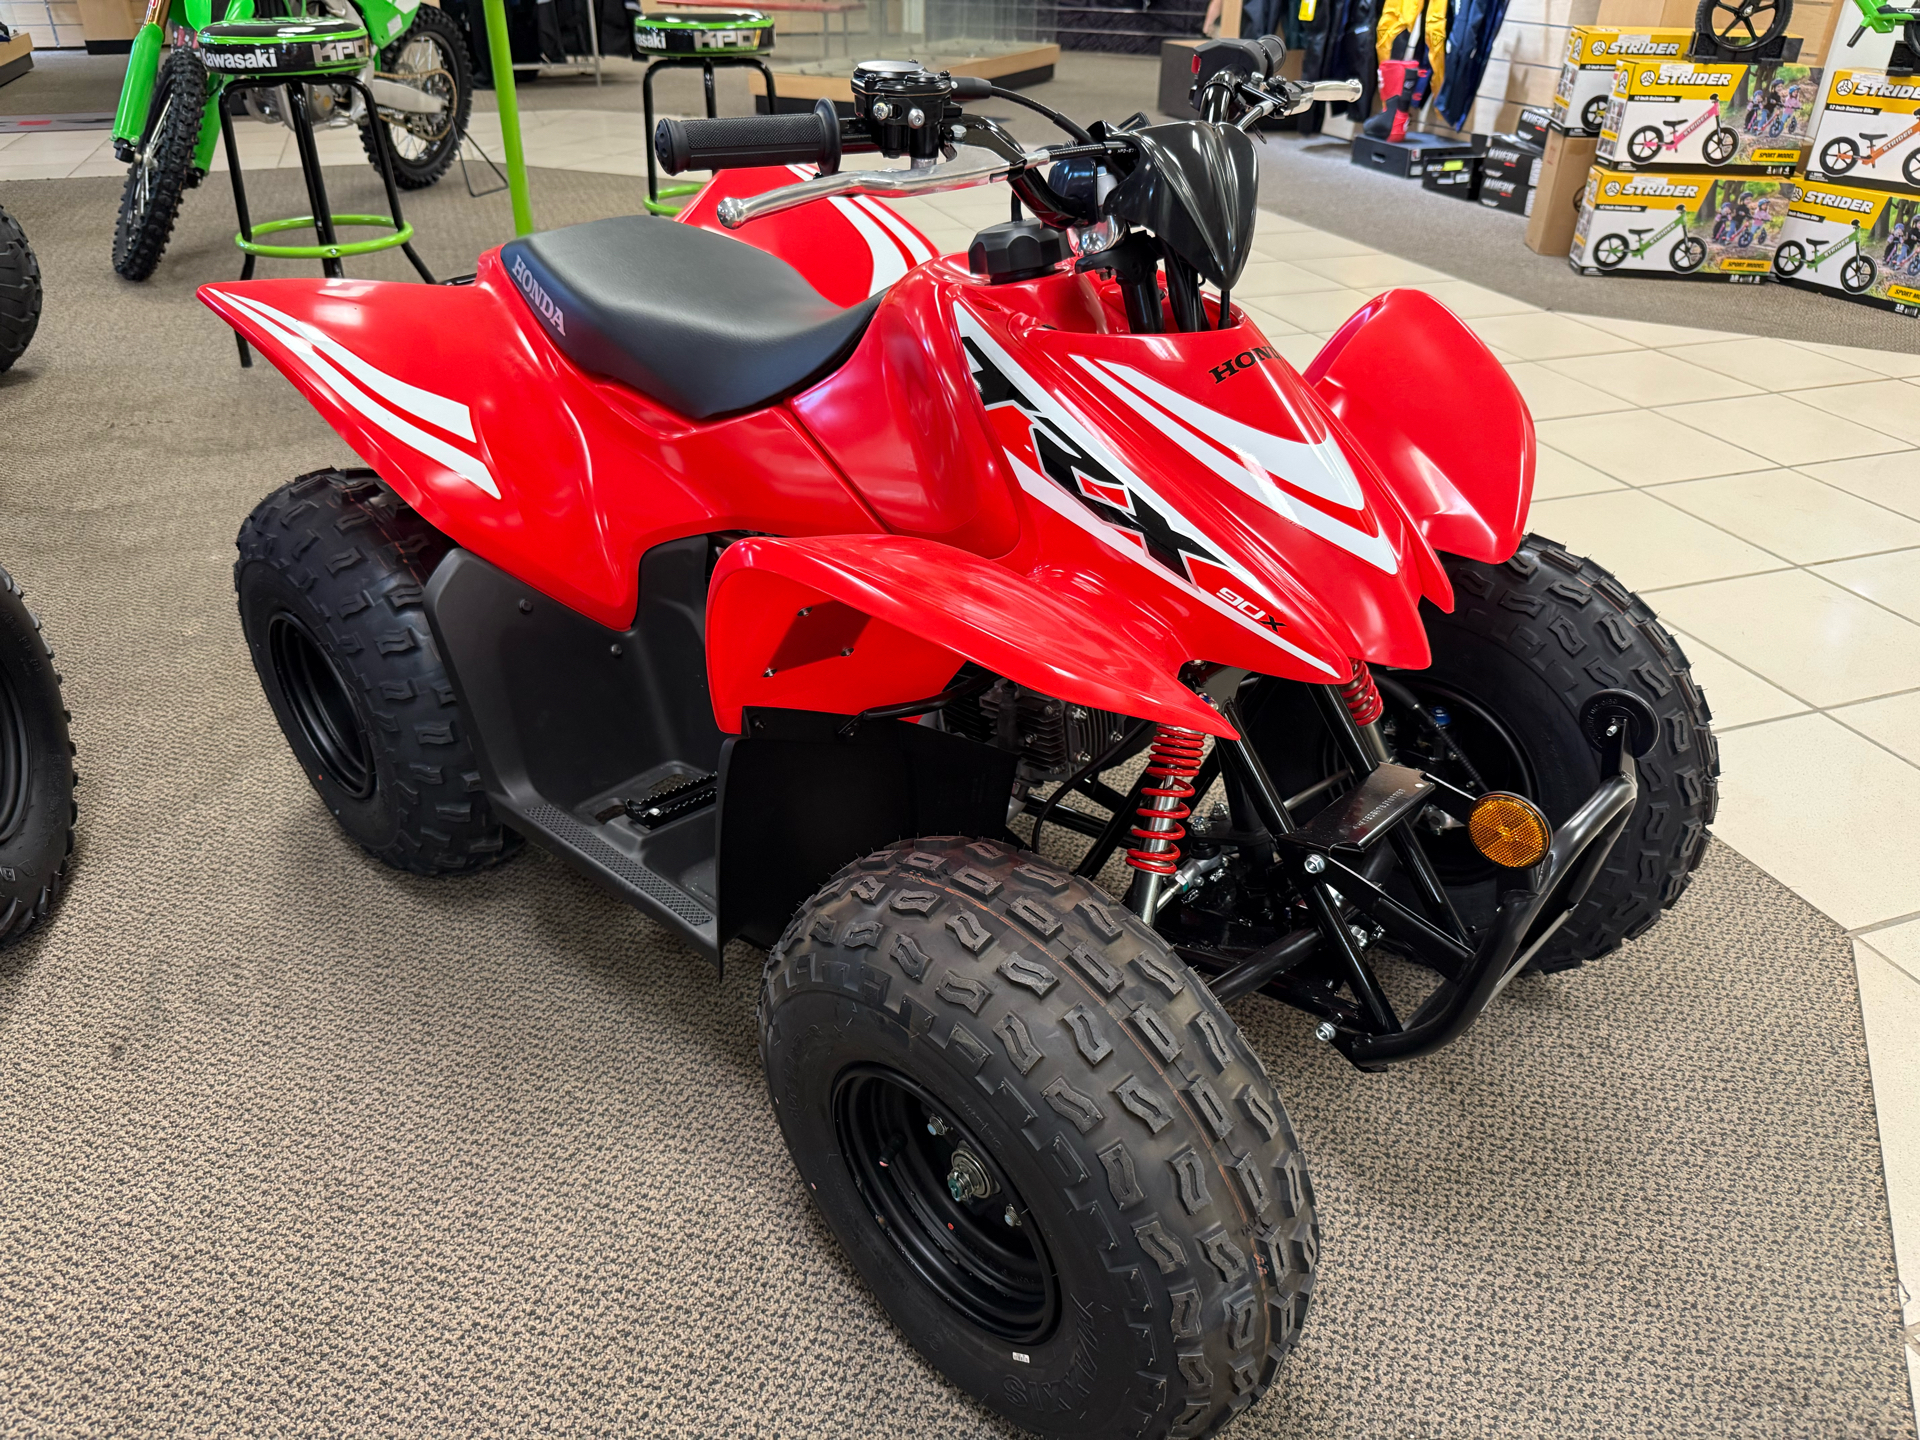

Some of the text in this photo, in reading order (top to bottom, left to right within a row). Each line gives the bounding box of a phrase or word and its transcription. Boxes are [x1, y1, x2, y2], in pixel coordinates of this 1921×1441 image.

[200, 47, 278, 69] Kawasaki
[1606, 43, 1680, 56] STRIDER
[1656, 72, 1733, 87] STRIDER
[1882, 128, 1914, 152] STRIDER
[1621, 183, 1700, 199] STRIDER
[1803, 190, 1875, 215] STRIDER
[1823, 237, 1850, 258] STRIDER
[511, 254, 566, 337] HONDA
[1894, 289, 1913, 299] SPORT
[1208, 345, 1281, 385] HON
